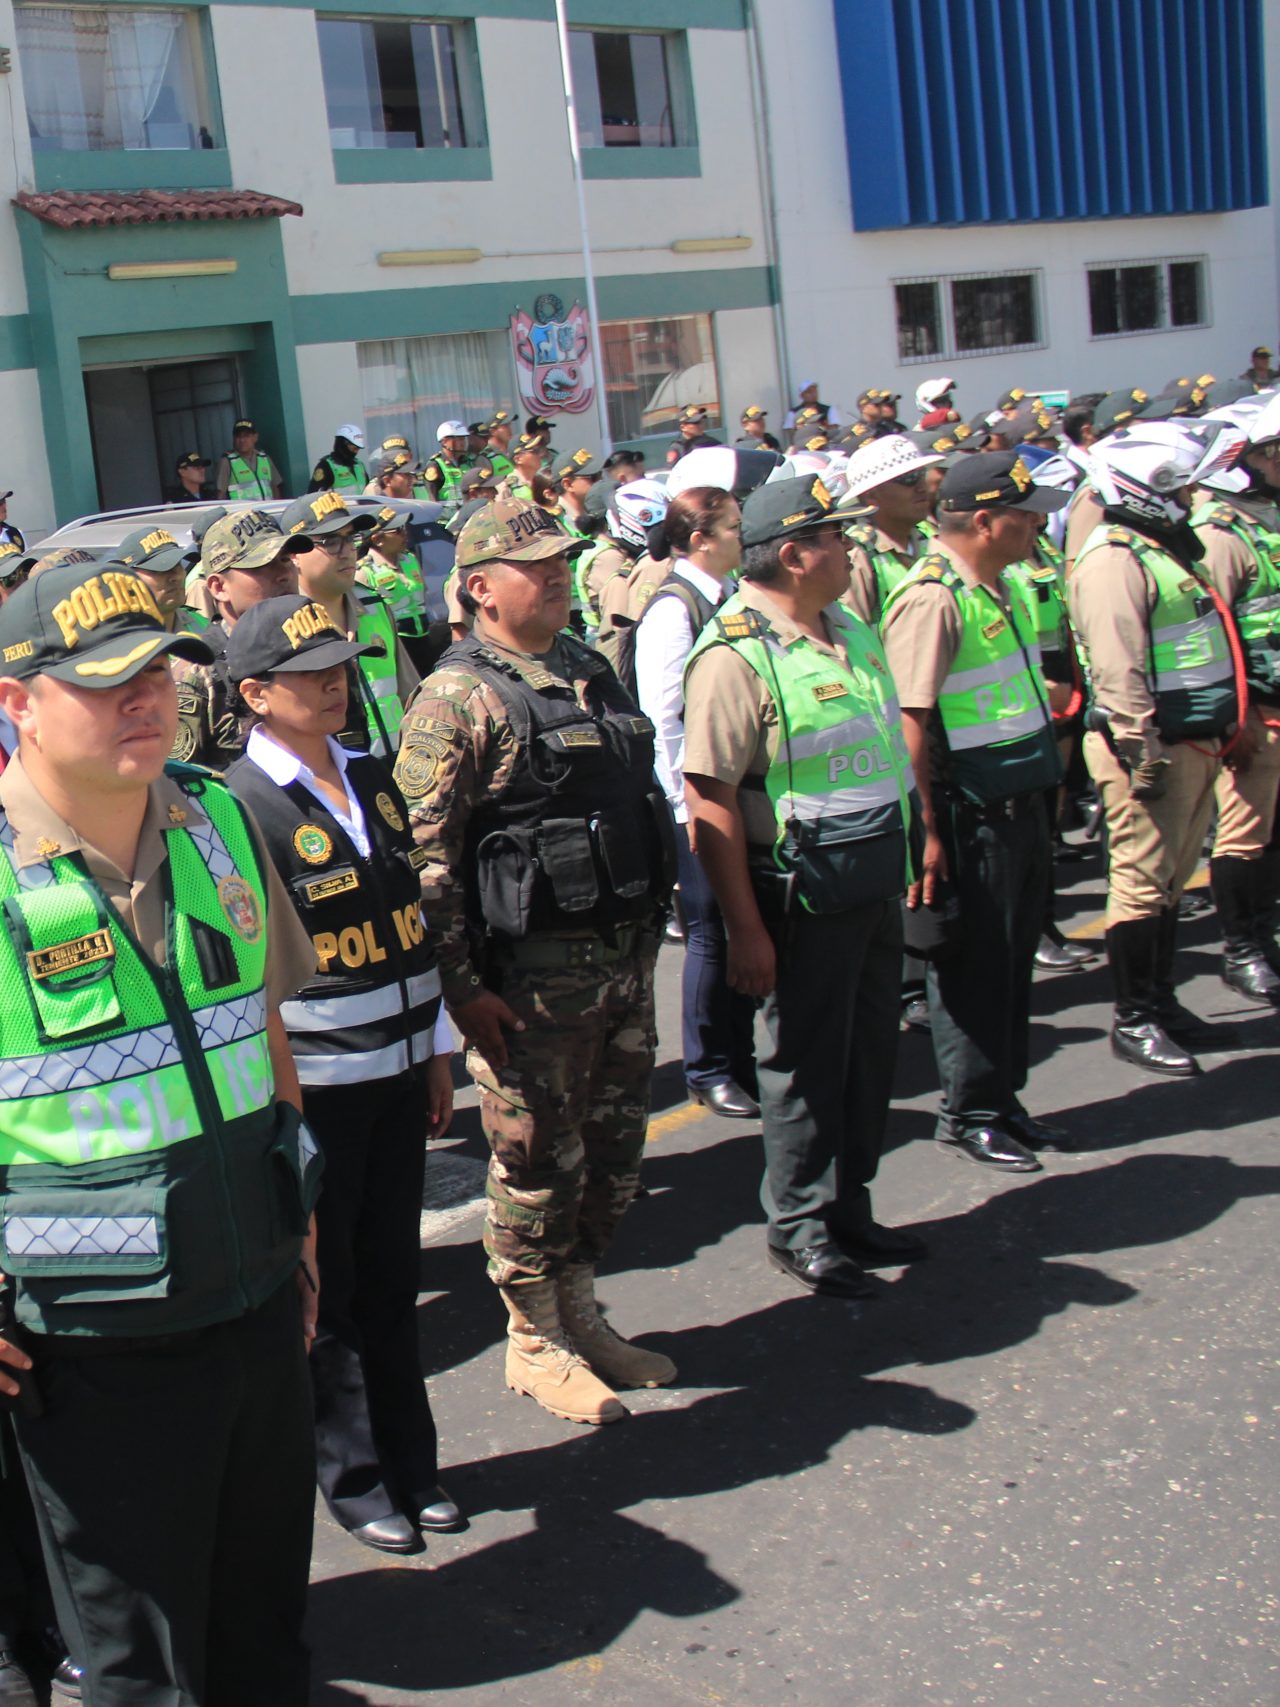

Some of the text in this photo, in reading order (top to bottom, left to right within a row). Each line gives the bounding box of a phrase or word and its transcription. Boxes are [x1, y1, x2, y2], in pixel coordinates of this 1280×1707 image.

[3, 640, 33, 663] PERU
[827, 744, 891, 784] POL
[48, 940, 92, 963] PORTILLA
[312, 920, 388, 973] POL
[67, 1073, 189, 1160] POL
